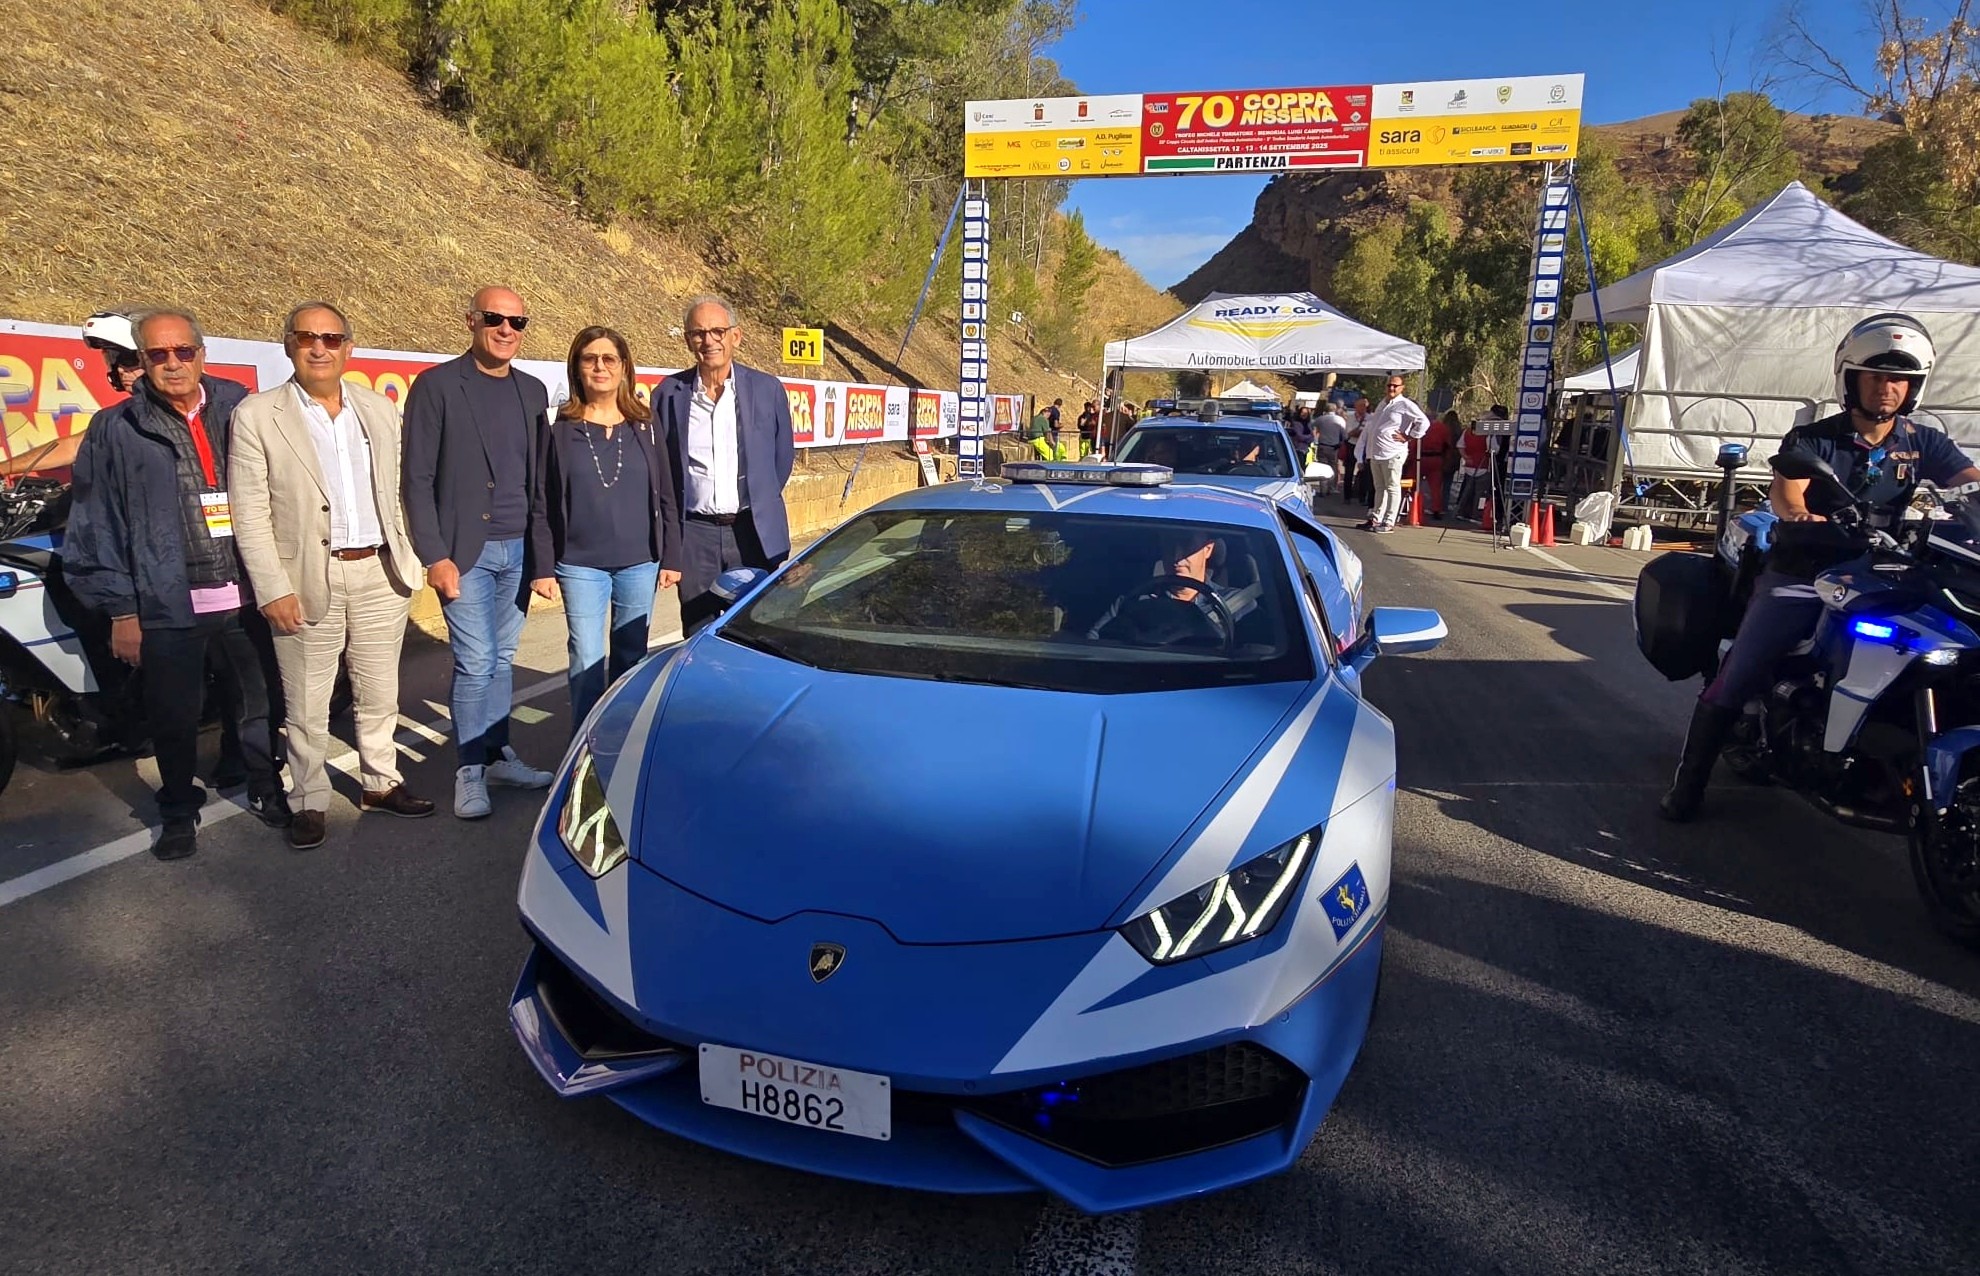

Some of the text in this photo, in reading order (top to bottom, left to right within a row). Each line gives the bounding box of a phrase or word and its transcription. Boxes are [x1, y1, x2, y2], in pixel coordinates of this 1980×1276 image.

[1243, 92, 1333, 111] COPPA
[1240, 107, 1338, 125] NISSENA
[1380, 130, 1421, 144] sara
[1216, 155, 1286, 169] PARTENZA
[1215, 305, 1321, 318] READY2GO
[790, 340, 815, 358] CP 1
[1289, 352, 1332, 366] d'Italia
[849, 392, 883, 413] COPPA
[739, 1053, 842, 1090] POLIZIA
[741, 1079, 844, 1130] H8862
